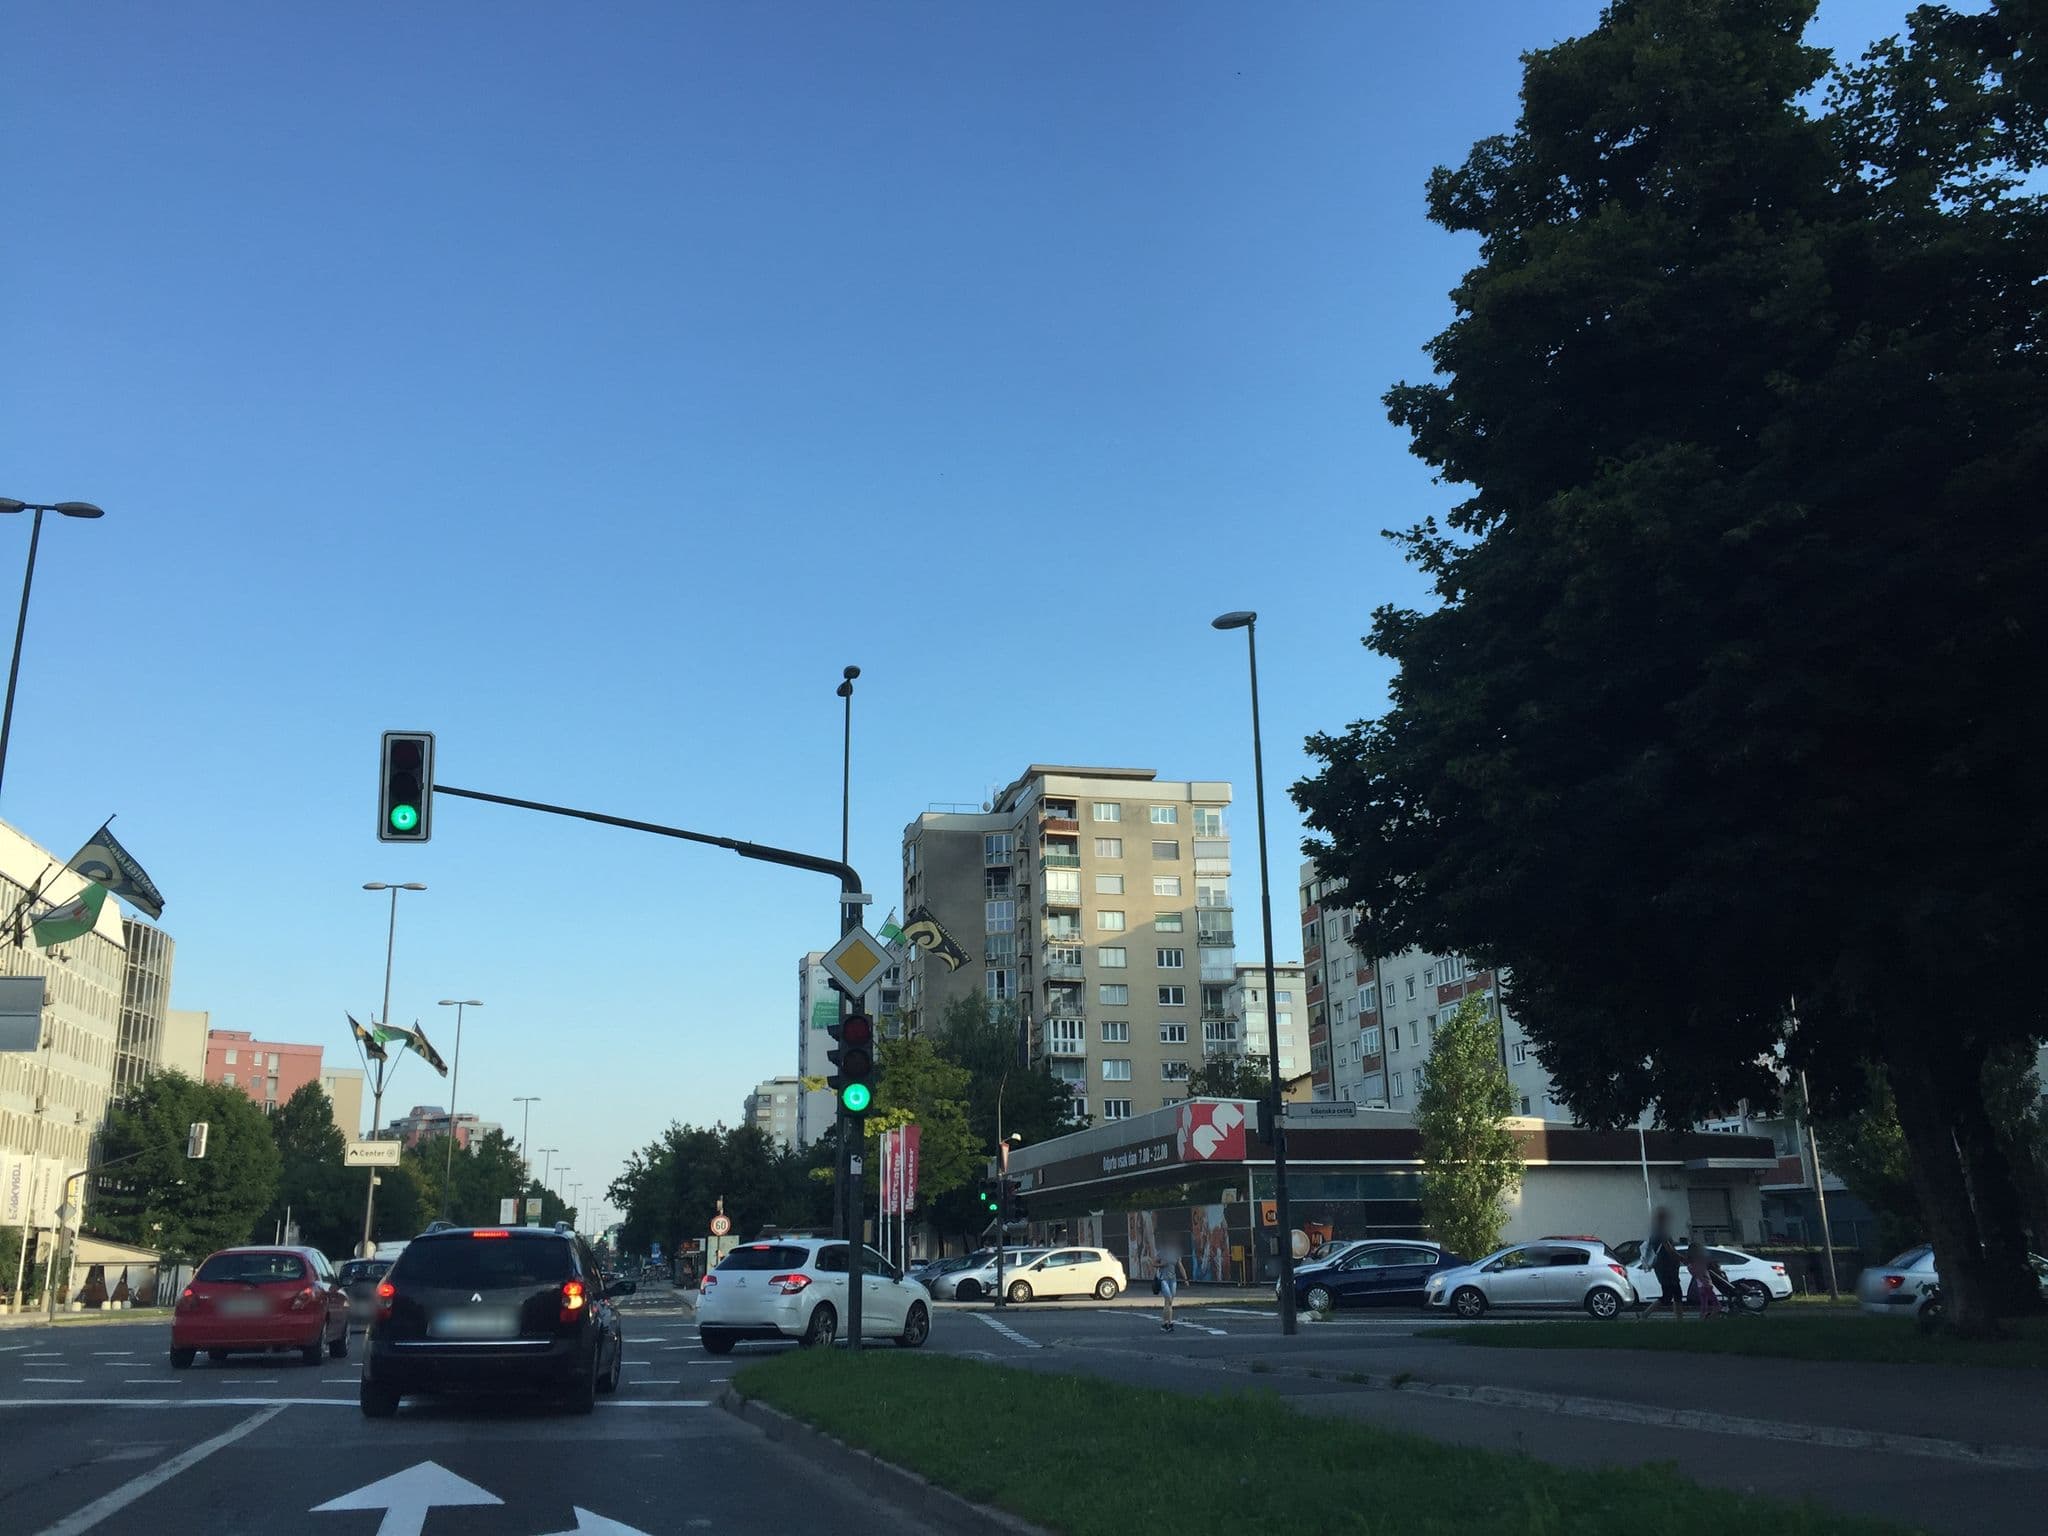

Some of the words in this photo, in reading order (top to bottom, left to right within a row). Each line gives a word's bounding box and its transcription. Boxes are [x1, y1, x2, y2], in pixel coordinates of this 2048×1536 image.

[890, 1152, 901, 1212] Mercator
[904, 1147, 915, 1210] Mercator
[715, 1220, 727, 1230] 60
